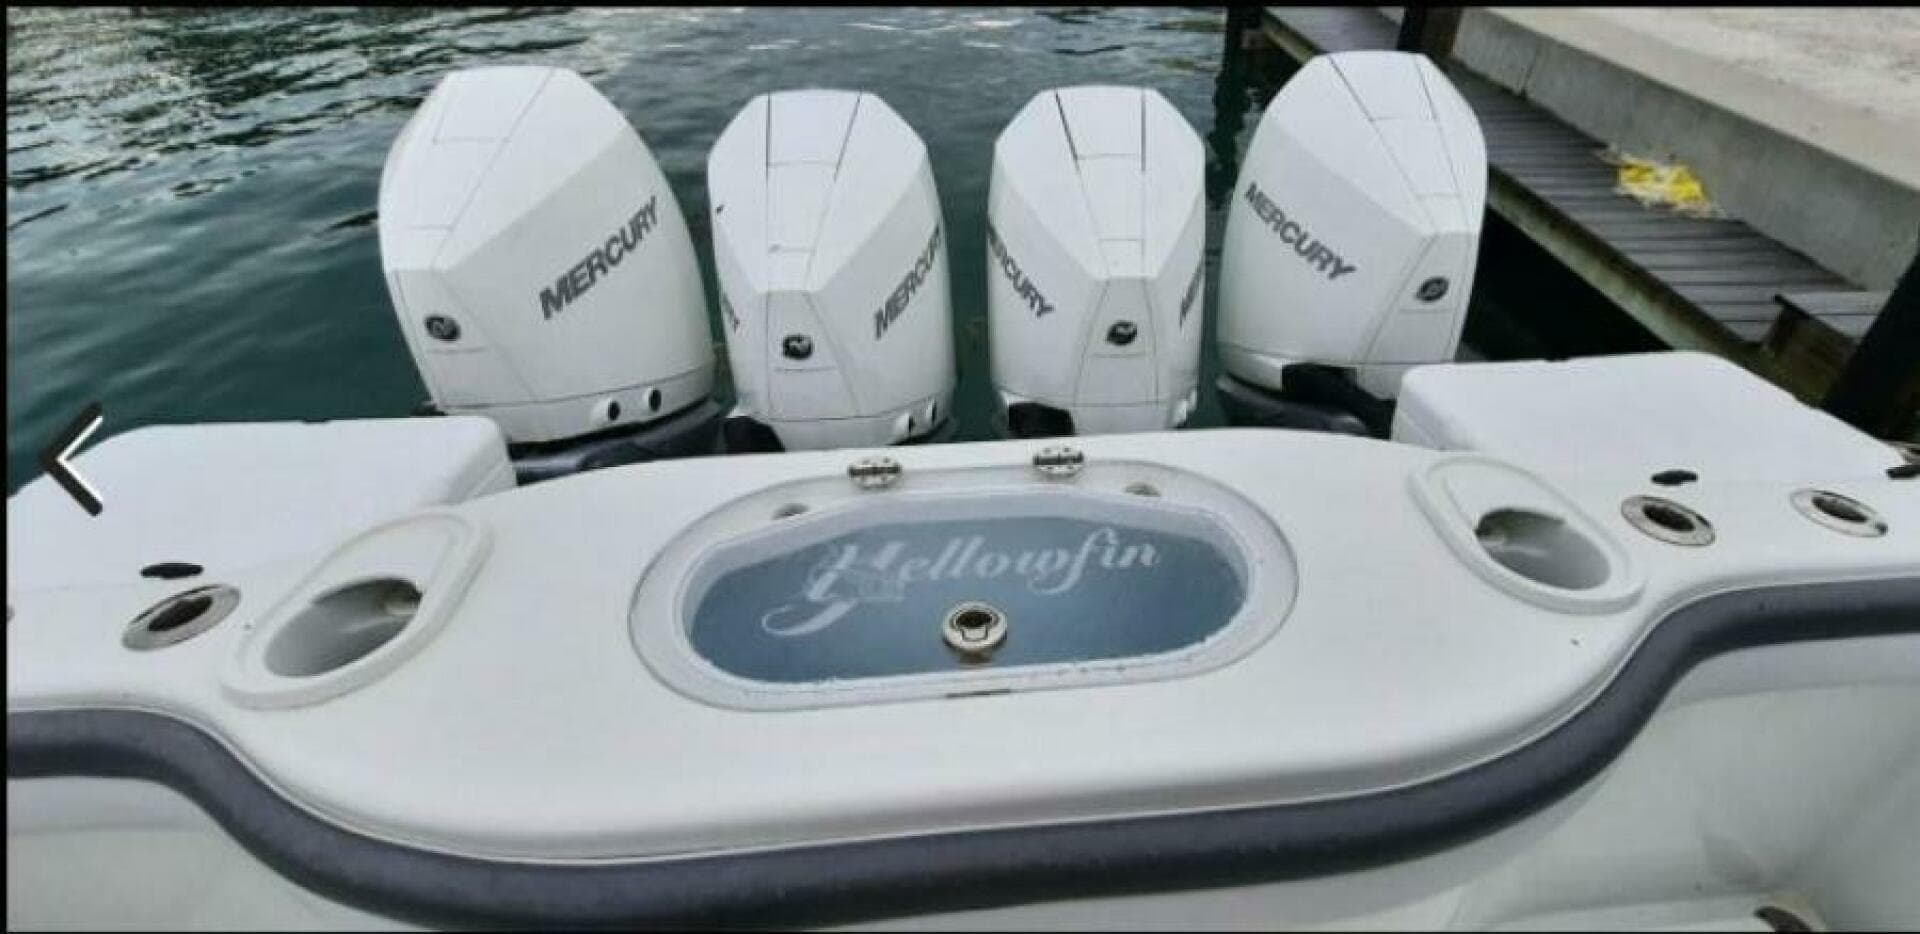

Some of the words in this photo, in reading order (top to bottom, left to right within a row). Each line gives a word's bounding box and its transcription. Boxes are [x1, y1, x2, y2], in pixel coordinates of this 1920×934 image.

[540, 195, 658, 319] MERCURY
[1245, 182, 1356, 280] MERCURY
[761, 526, 1160, 637] Yellowfin
